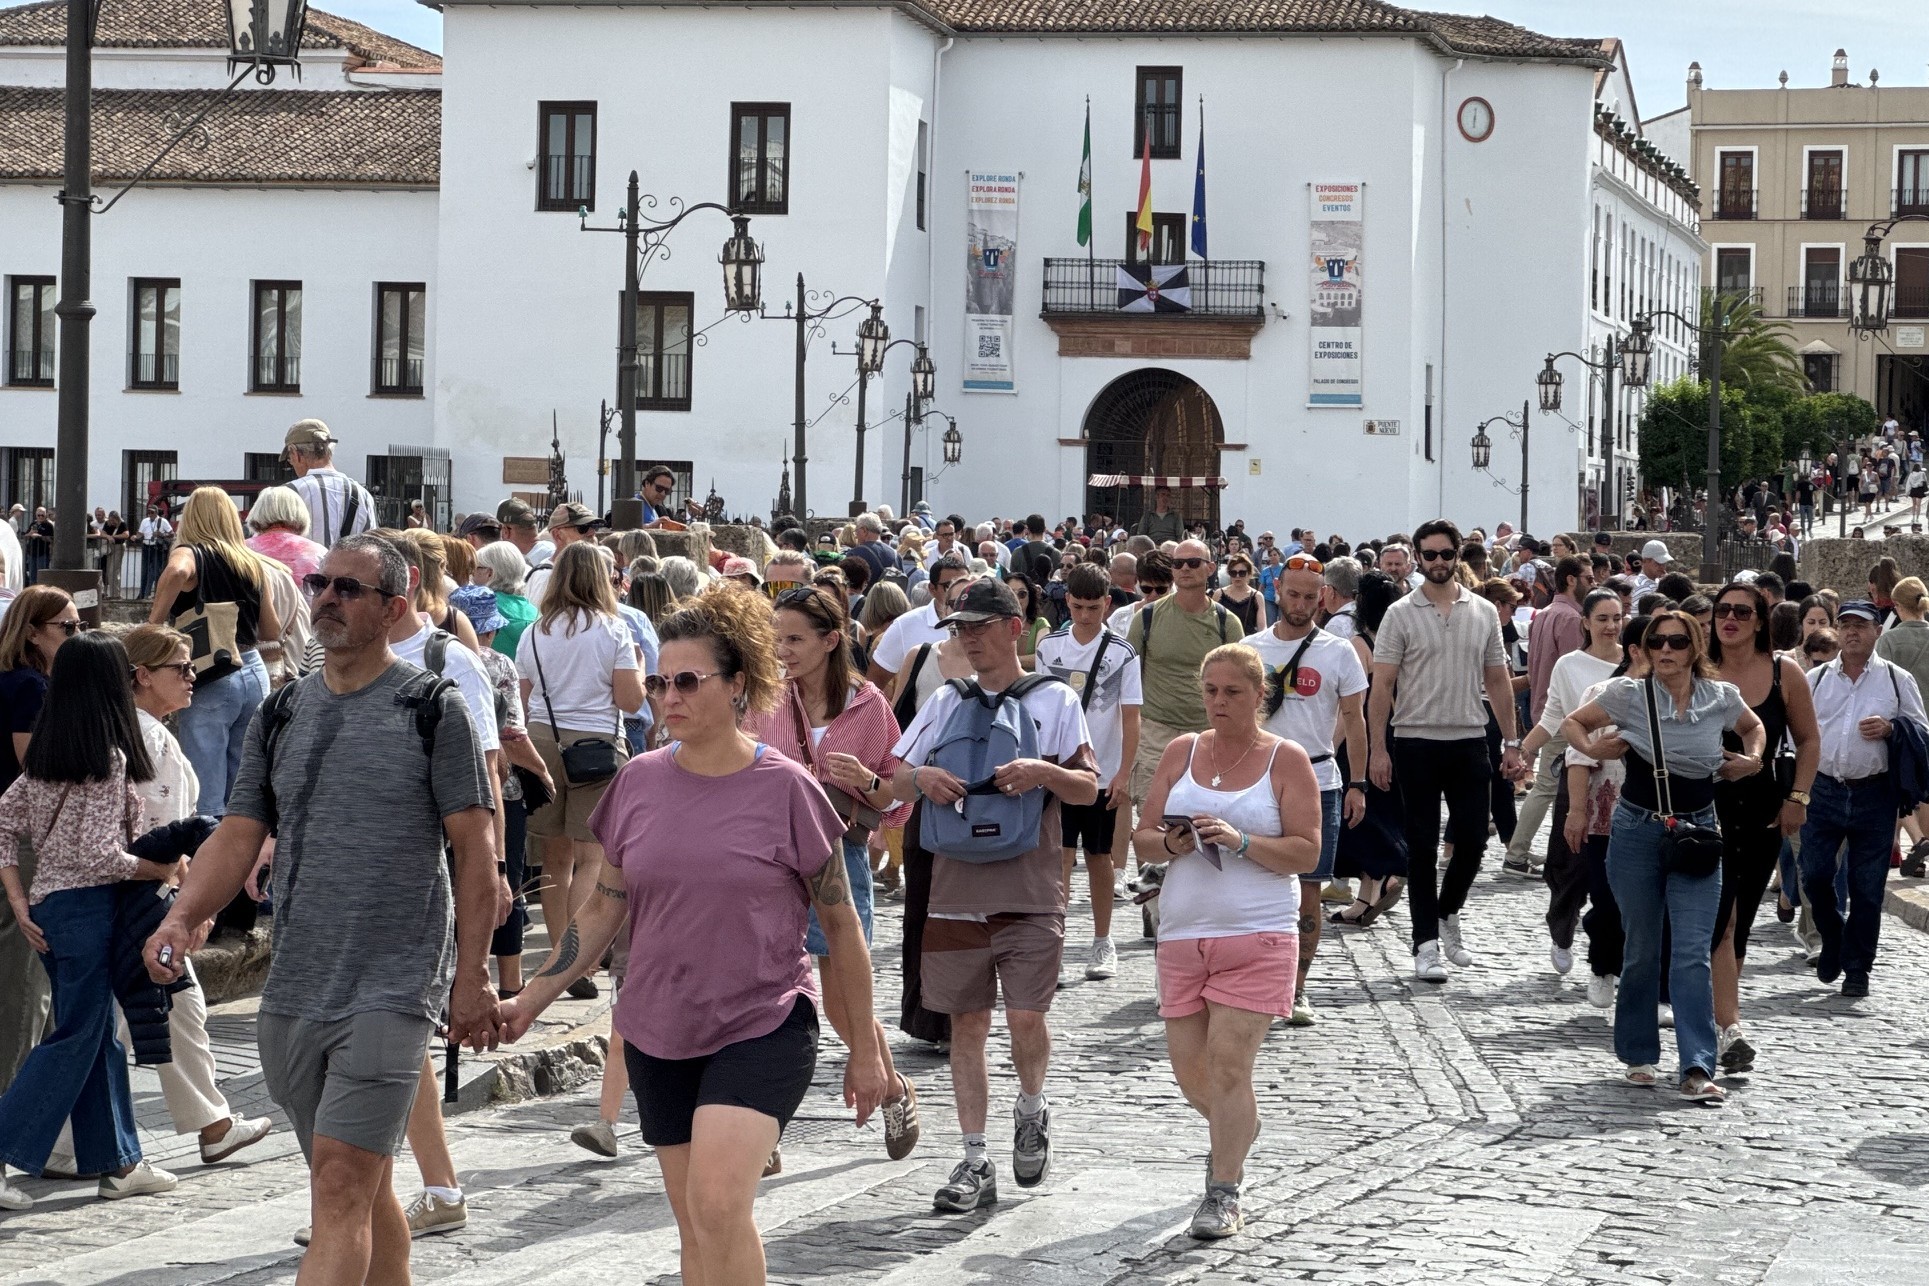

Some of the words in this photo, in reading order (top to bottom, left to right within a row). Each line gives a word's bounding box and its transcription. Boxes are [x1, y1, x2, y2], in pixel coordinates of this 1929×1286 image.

[1322, 204, 1351, 212] EVENTOS
[1318, 341, 1344, 349] CENTRO
[1344, 341, 1353, 349] DE
[1314, 351, 1358, 359] EXPOSICIONES
